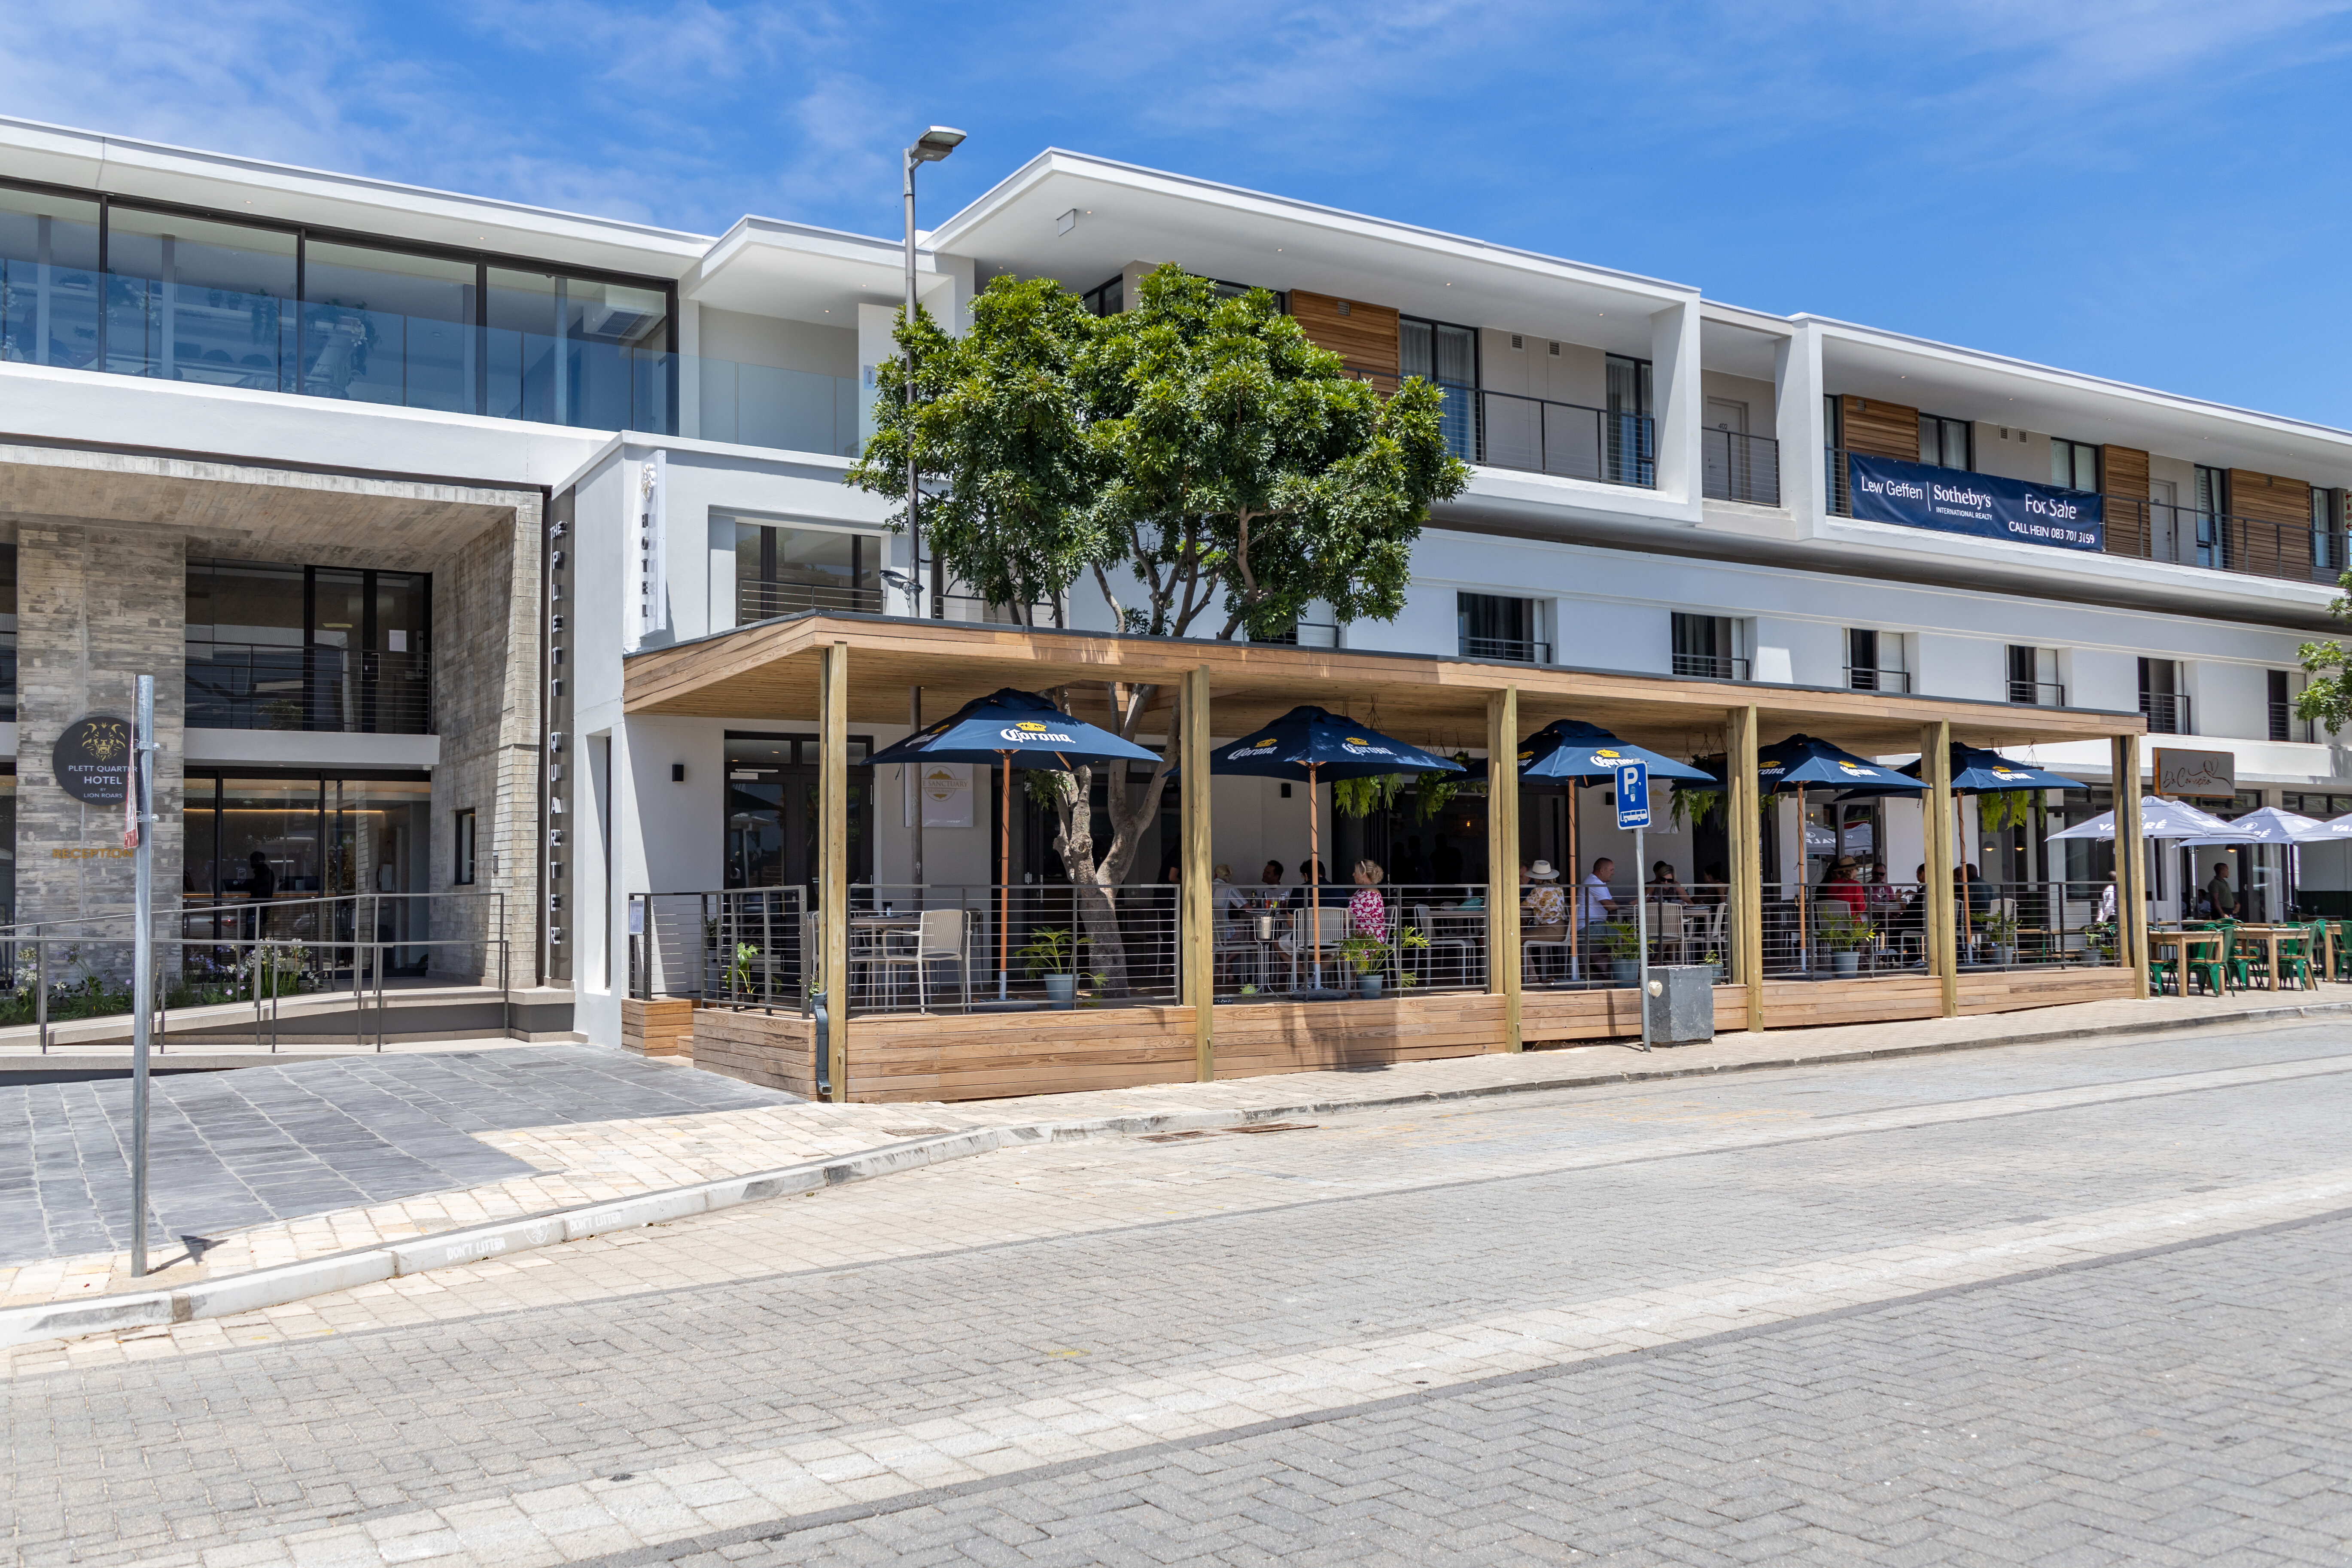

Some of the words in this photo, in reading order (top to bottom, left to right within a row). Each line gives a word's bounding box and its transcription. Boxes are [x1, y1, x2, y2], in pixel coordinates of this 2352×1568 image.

[1862, 476, 1883, 494] Lew
[1886, 480, 1923, 500] Geffen
[1934, 484, 1991, 510] Sotheby's
[1936, 507, 1975, 518] INTERNATIONAL
[1975, 512, 1992, 521] REALTY
[2025, 494, 2046, 513] For
[2049, 499, 2076, 520] Sale
[550, 521, 566, 539] THE
[2009, 521, 2029, 534] CALL
[2030, 525, 2049, 537] HEIN
[2051, 527, 2064, 539] 083
[2066, 530, 2077, 542] 701
[2078, 532, 2095, 544] 3159
[552, 551, 563, 697] PLETT
[1001, 728, 1076, 743] Corona
[1228, 746, 1278, 760] Corona
[1342, 743, 1397, 756] Corona
[84, 776, 122, 784] HOTEL
[1624, 767, 1638, 795] P
[2163, 770, 2176, 788] Do
[551, 732, 562, 944] QUARTER
[53, 848, 134, 859] RECEPTION
[569, 1217, 592, 1232] DON'T
[595, 1212, 622, 1227] LITTER
[446, 1243, 472, 1260] DON'T
[476, 1237, 506, 1254] LITTER
